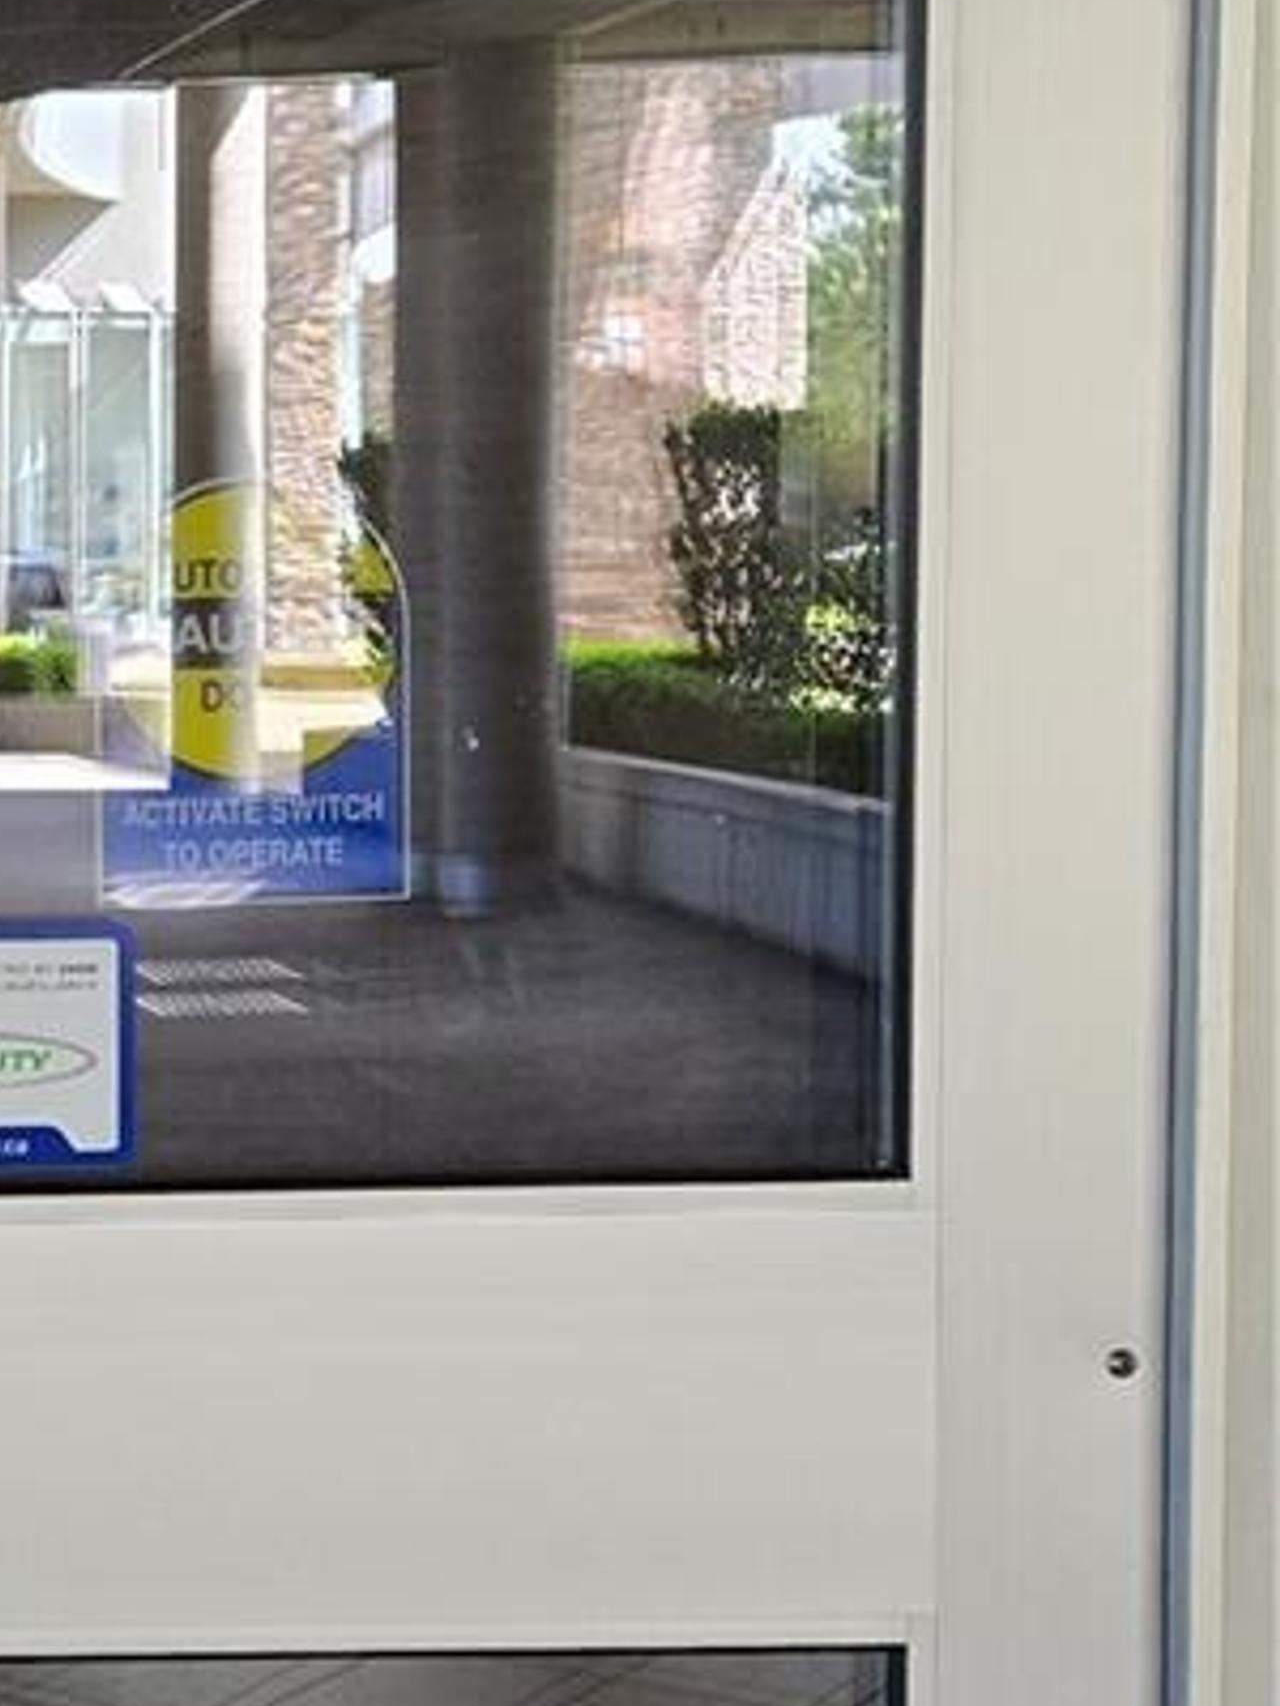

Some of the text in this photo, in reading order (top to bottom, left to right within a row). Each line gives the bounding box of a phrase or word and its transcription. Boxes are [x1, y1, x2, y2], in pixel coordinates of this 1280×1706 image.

[122, 791, 384, 827] ACTIVATE SWITCH
[163, 836, 344, 872] TO OPERATE
